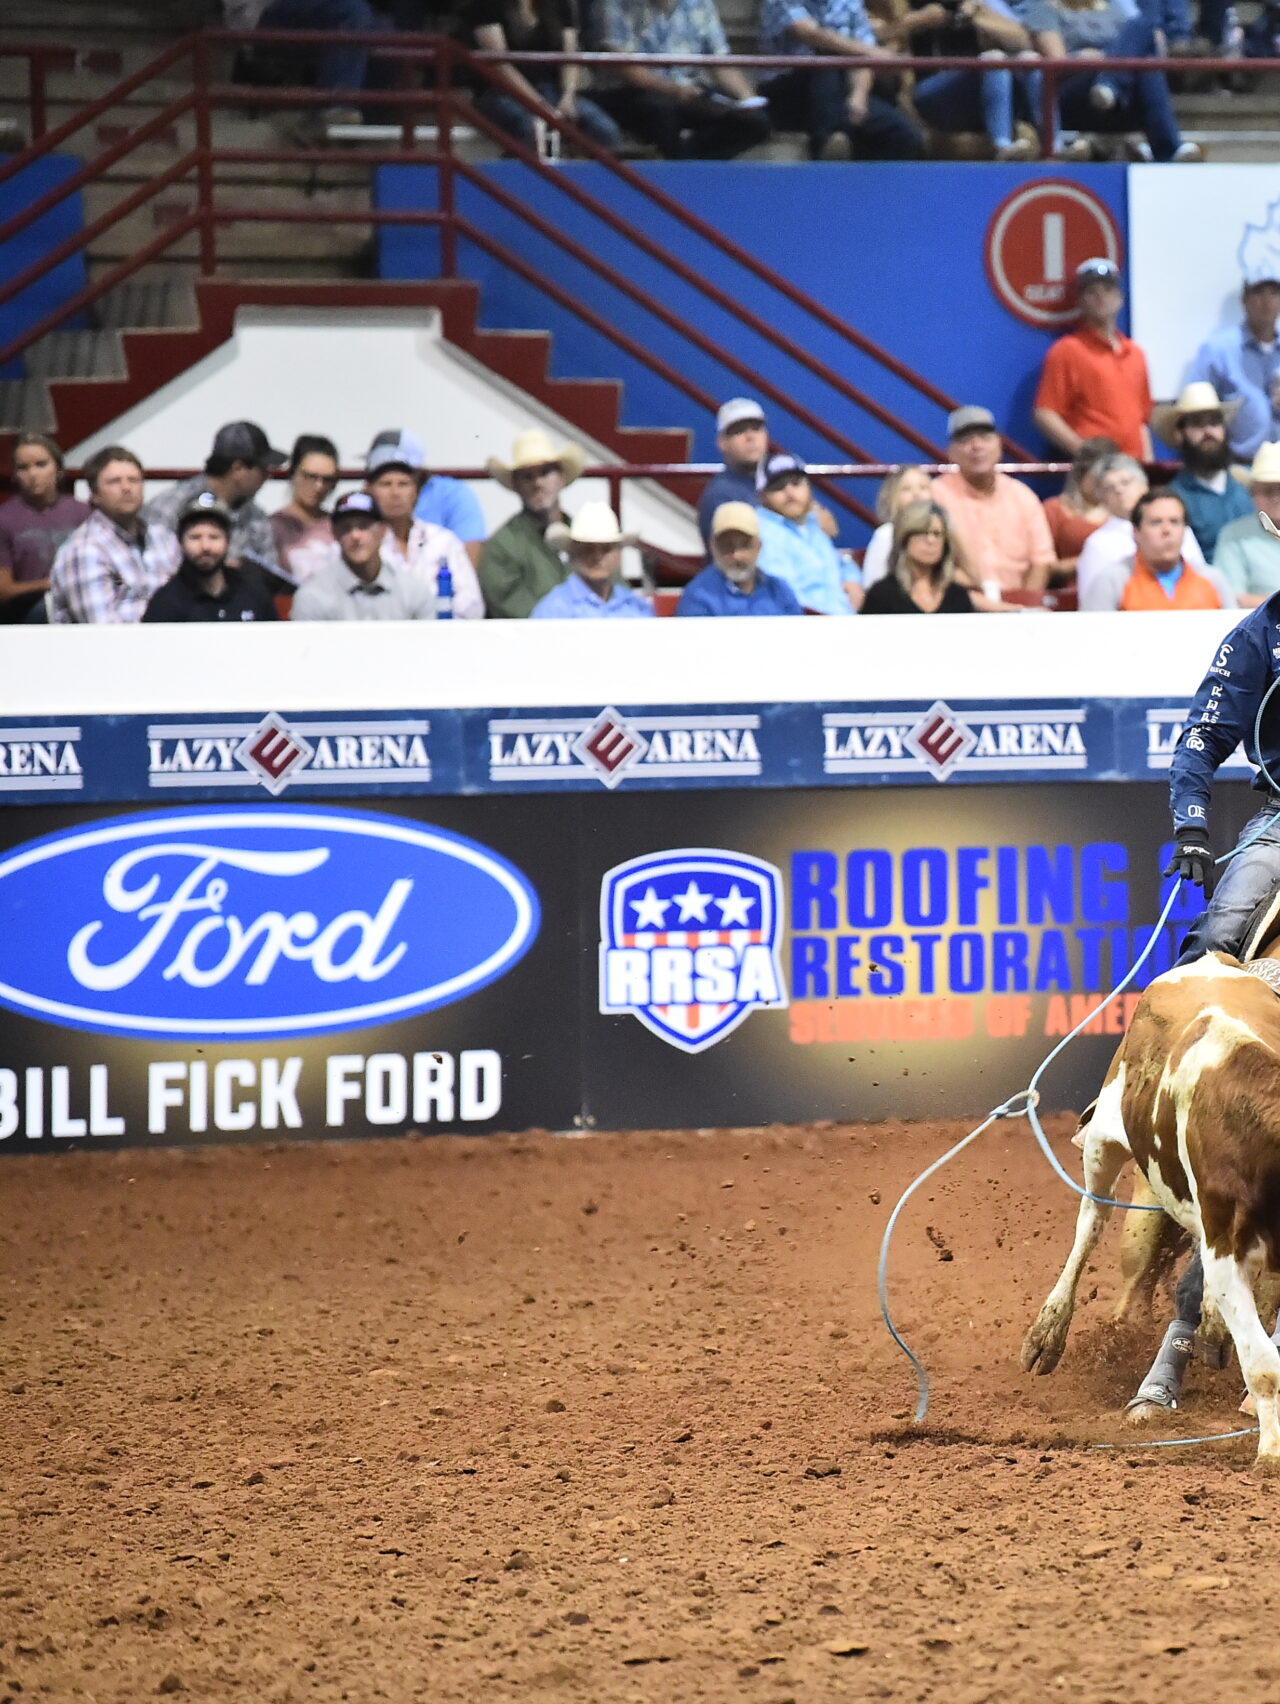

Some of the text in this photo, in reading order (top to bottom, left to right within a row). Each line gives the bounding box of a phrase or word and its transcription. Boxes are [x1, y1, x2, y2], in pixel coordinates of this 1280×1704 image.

[150, 737, 239, 771] LAZY
[312, 734, 430, 768] ARENA
[489, 732, 573, 765] LAZY
[646, 728, 759, 762] ARENA
[824, 726, 908, 757] LAZY
[976, 723, 1085, 755] ARENA
[67, 842, 414, 991] Ford
[791, 842, 1129, 930] ROOFING
[606, 944, 780, 1006] RRSA
[791, 925, 1188, 998] RESTORATIO
[789, 999, 974, 1044] SERVICES
[985, 997, 1031, 1037] OF
[148, 1058, 303, 1133] FICK
[326, 1050, 502, 1127] FORD
